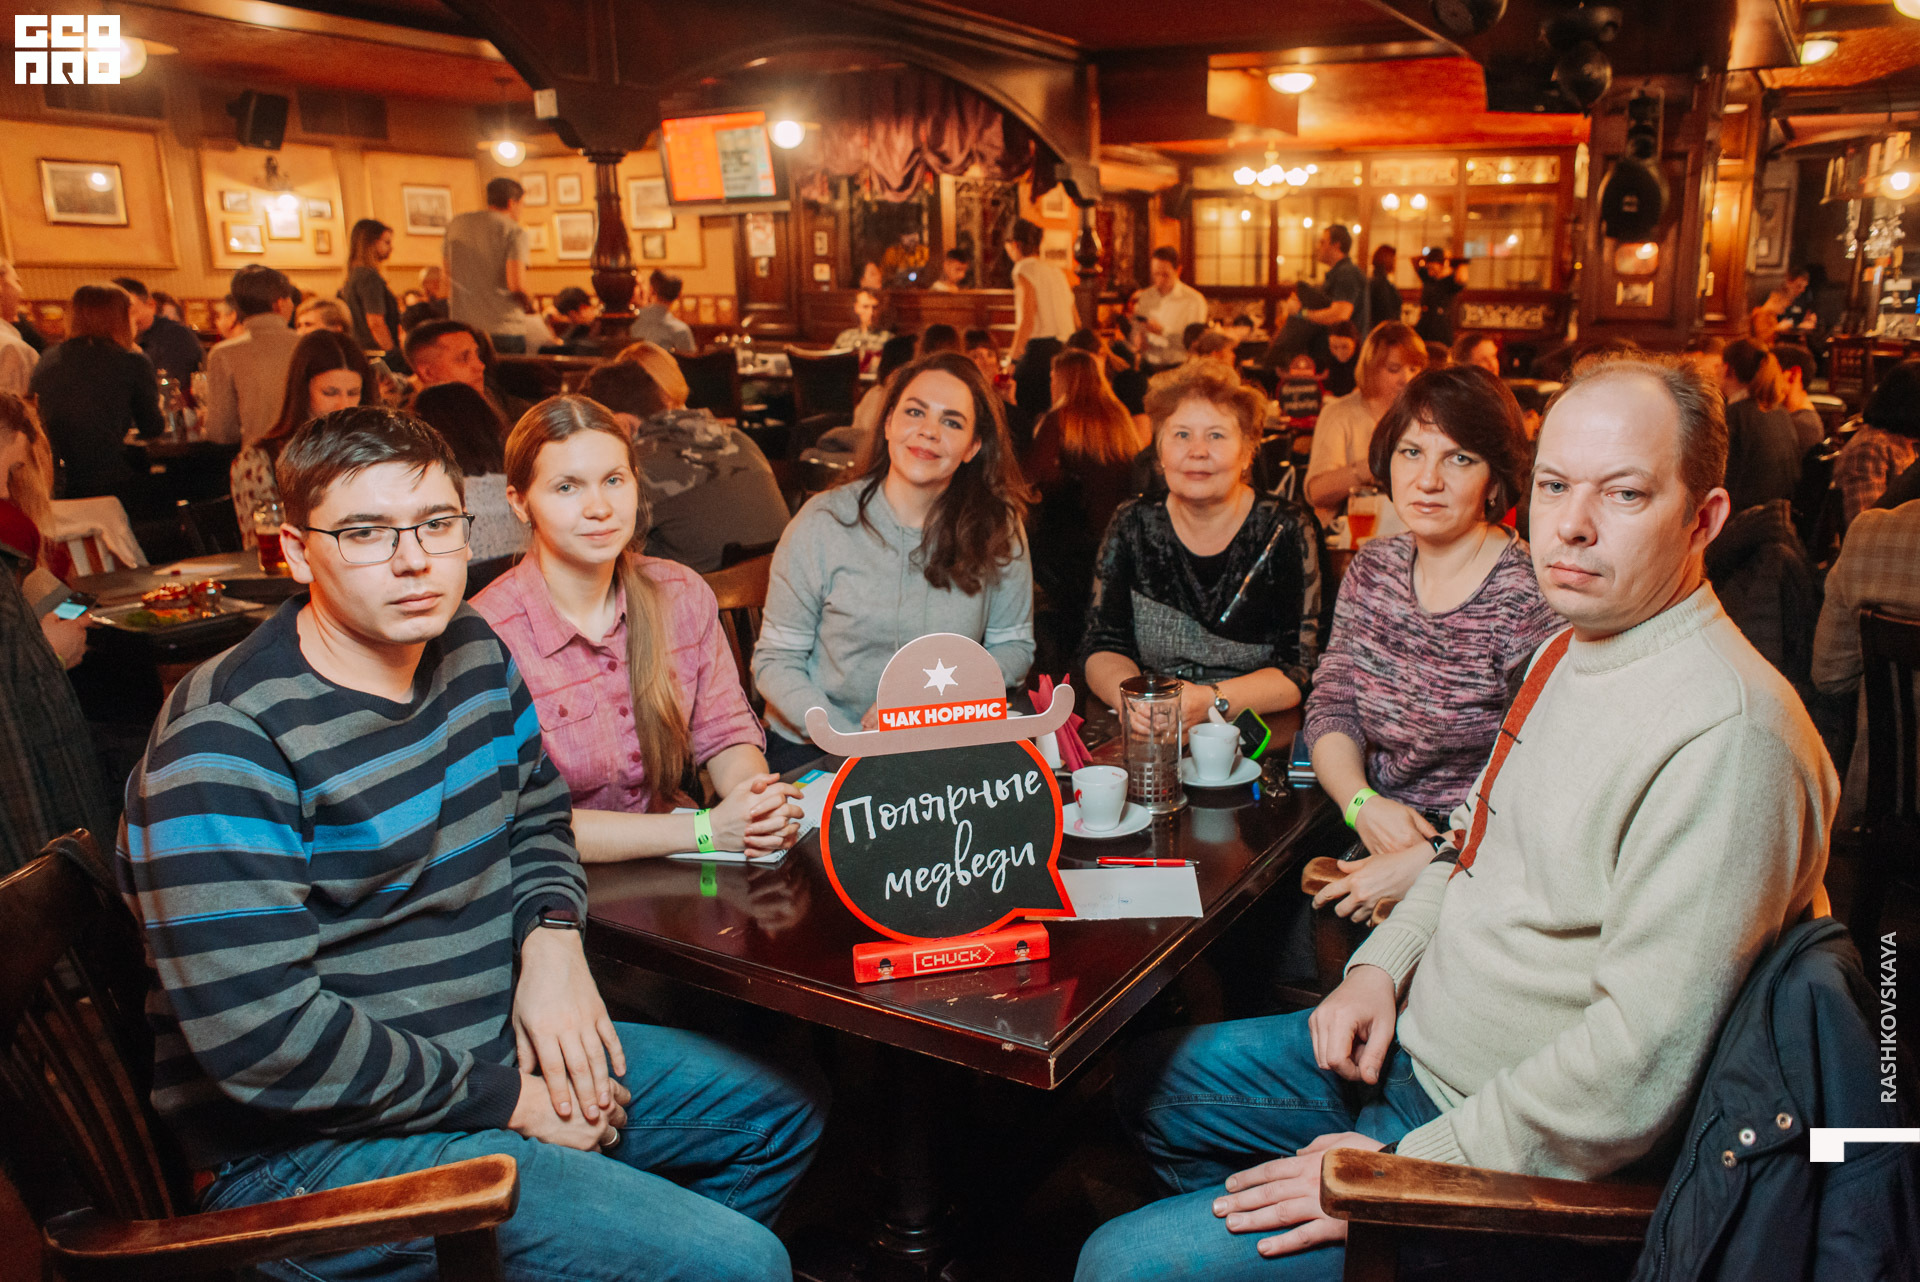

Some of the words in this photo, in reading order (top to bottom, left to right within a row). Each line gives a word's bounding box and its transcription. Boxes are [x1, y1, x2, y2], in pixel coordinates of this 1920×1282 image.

[882, 709, 922, 728] ЧАК
[924, 702, 1002, 724] НОРРИС
[835, 770, 1042, 844] Полярные
[885, 819, 1036, 908] медведи
[921, 949, 982, 968] CHUCK
